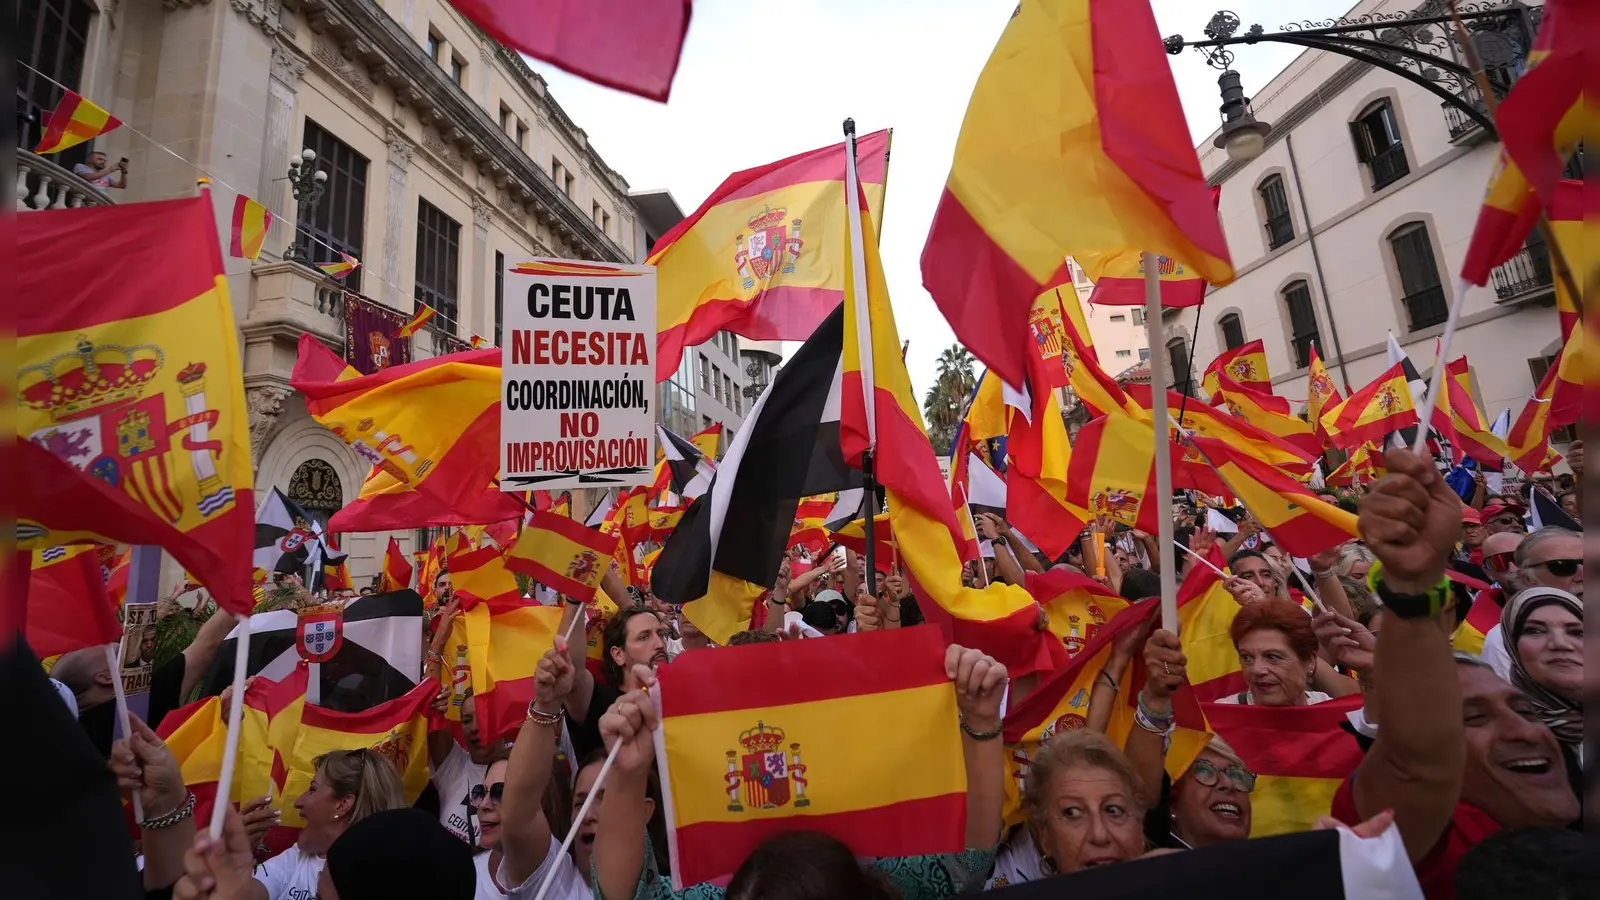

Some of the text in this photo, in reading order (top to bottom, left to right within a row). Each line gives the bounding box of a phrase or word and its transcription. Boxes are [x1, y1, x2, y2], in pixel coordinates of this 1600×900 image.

[527, 283, 636, 321] CEUTA
[511, 329, 649, 365] NECESITA
[506, 373, 649, 414] COORDINACIÓN,
[560, 411, 599, 438] NO
[506, 431, 648, 473] IMPROVISACIÓN
[128, 611, 144, 625] SE
[448, 813, 469, 833] CEUT
